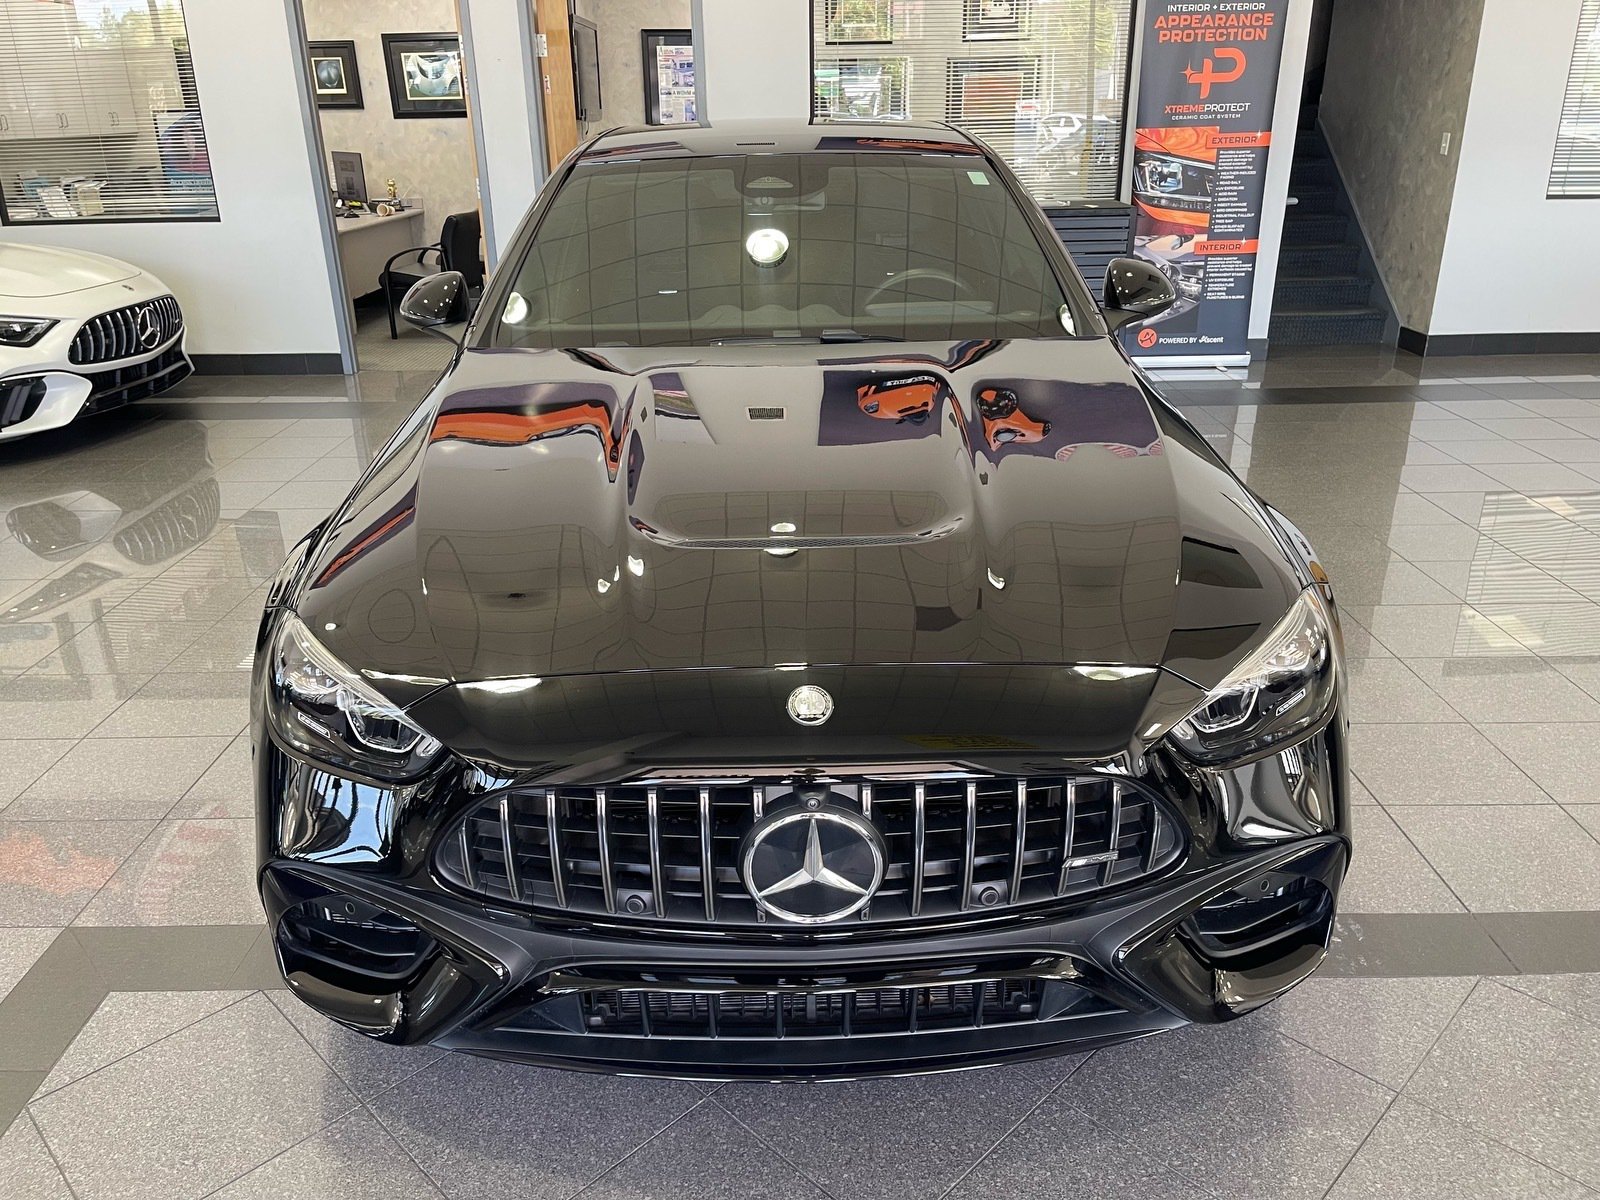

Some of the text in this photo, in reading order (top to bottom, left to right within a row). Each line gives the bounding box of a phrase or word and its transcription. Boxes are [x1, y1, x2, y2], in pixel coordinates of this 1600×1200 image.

[1168, 4, 1210, 12] INTERIOR
[1220, 3, 1265, 11] EXTERIOR
[1154, 13, 1274, 28] APPEARANCE
[1158, 28, 1268, 43] PROTECTION
[1164, 103, 1251, 114] XTREMEPROTECT
